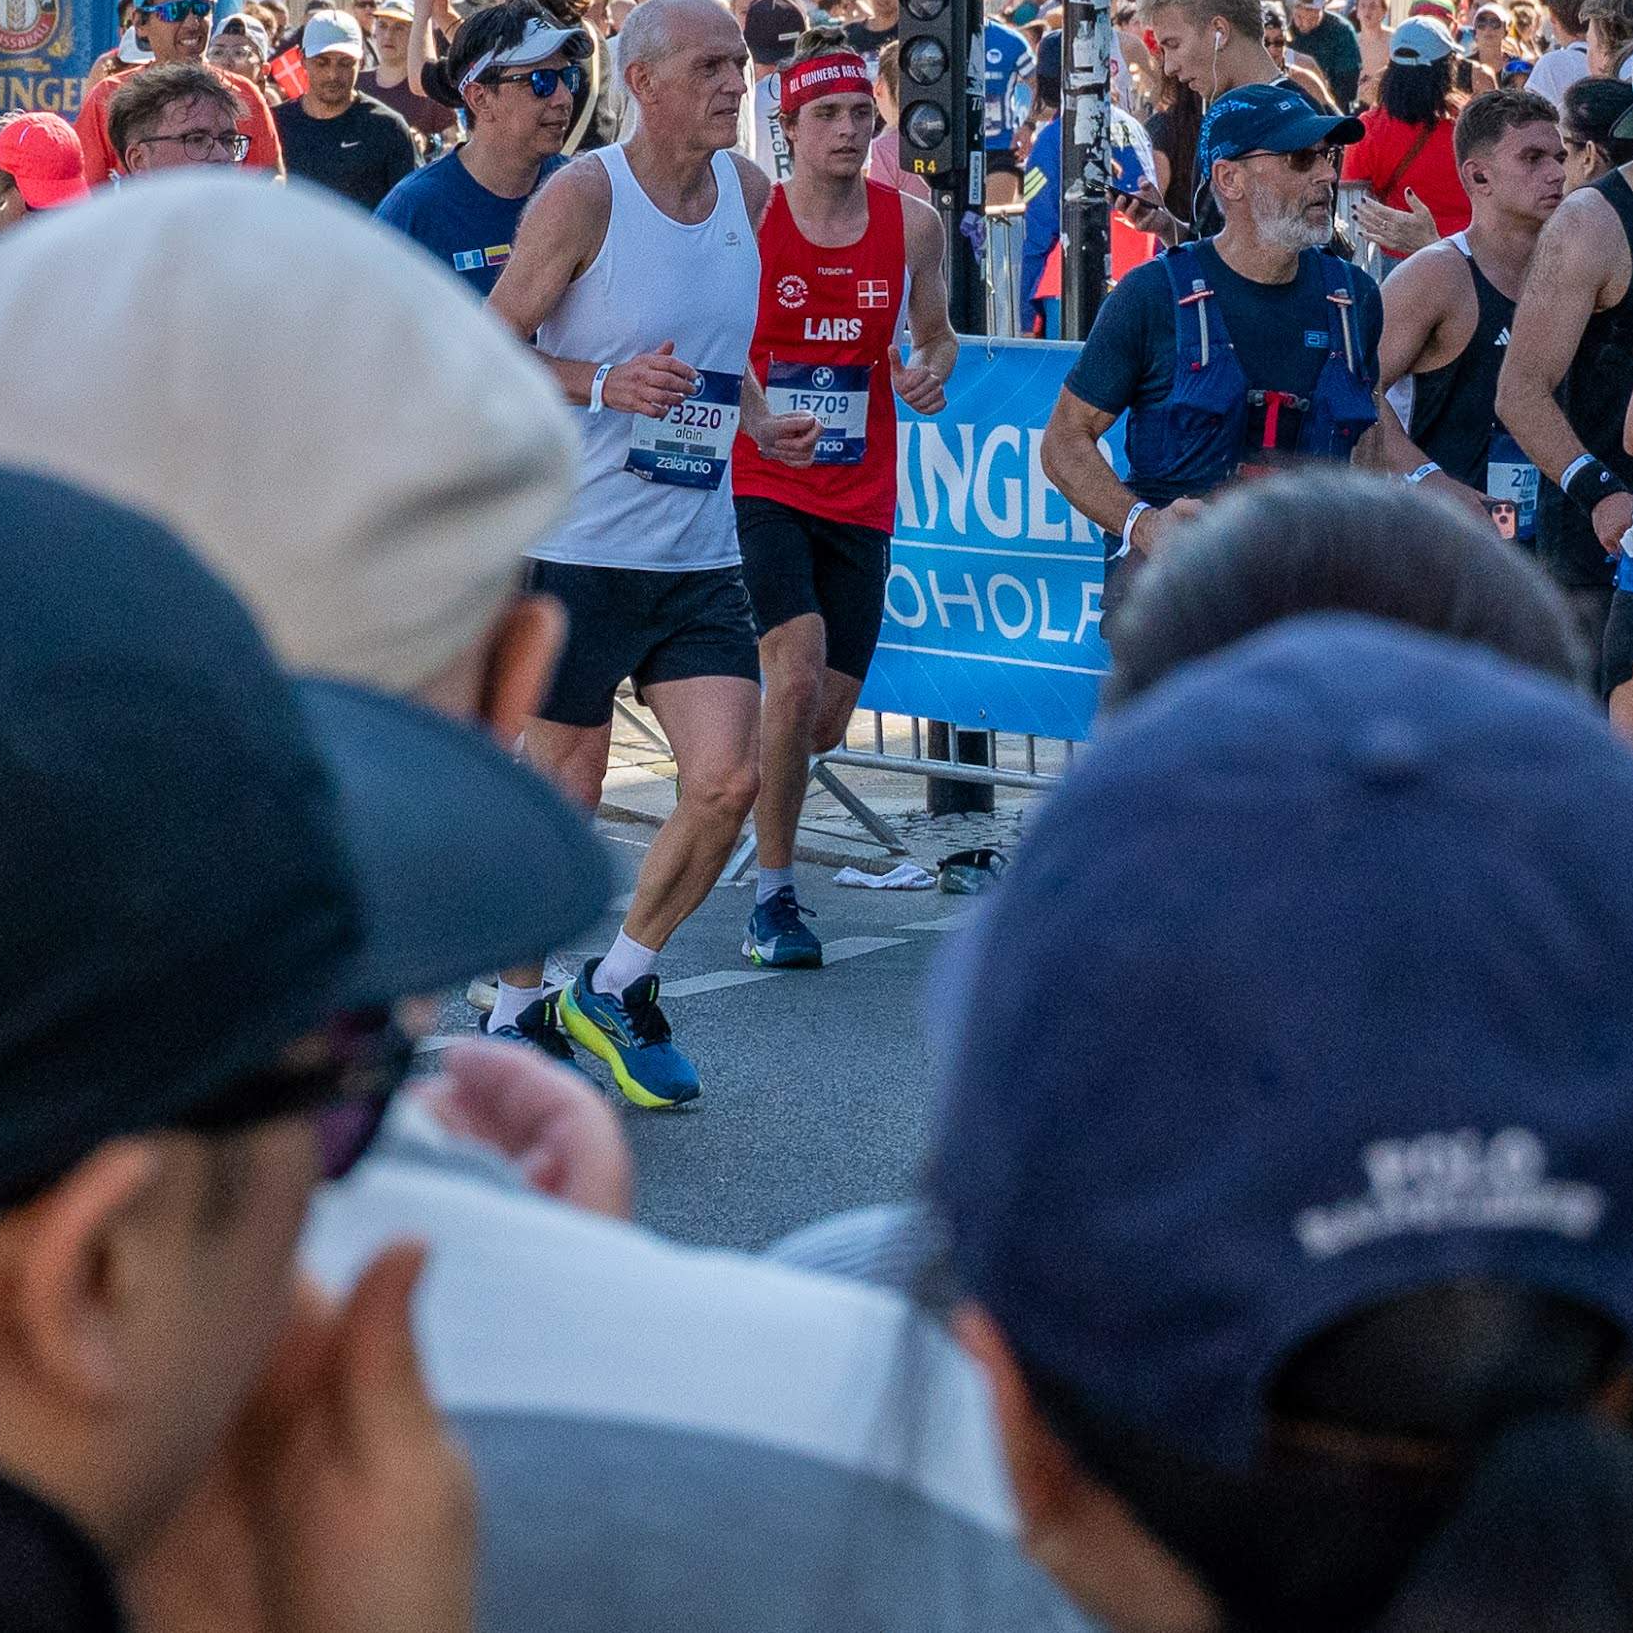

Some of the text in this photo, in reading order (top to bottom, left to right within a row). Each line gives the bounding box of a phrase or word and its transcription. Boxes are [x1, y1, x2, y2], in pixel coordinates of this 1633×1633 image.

[804, 317, 862, 341] LARS
[789, 393, 849, 414] 15709
[658, 404, 722, 430] 3220
[655, 455, 712, 475] zalando
